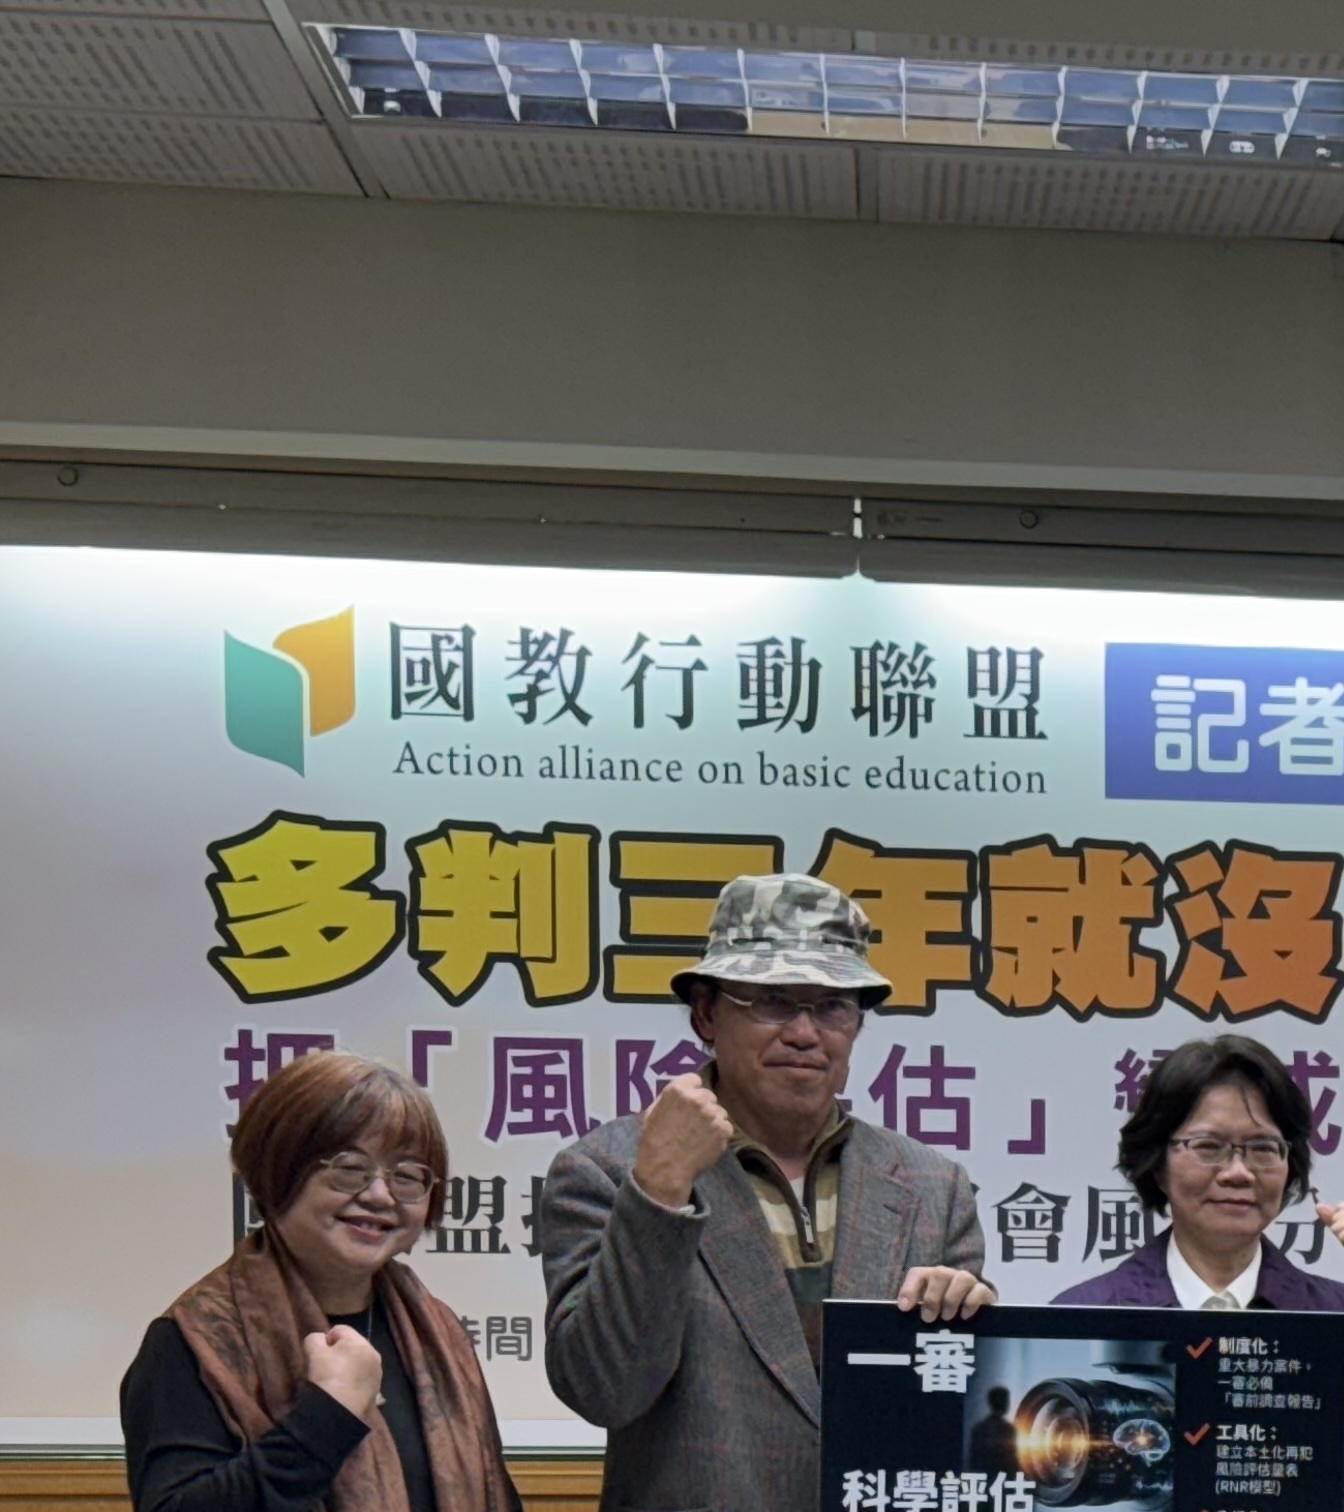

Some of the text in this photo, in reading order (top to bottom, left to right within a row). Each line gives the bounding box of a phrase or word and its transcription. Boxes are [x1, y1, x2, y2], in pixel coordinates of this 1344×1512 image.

[389, 621, 1047, 741] 國教行動聯盟
[393, 741, 1047, 796] Action alliance on basic education
[847, 1330, 976, 1394] 一審
[1216, 1424, 1278, 1441] 工具化：
